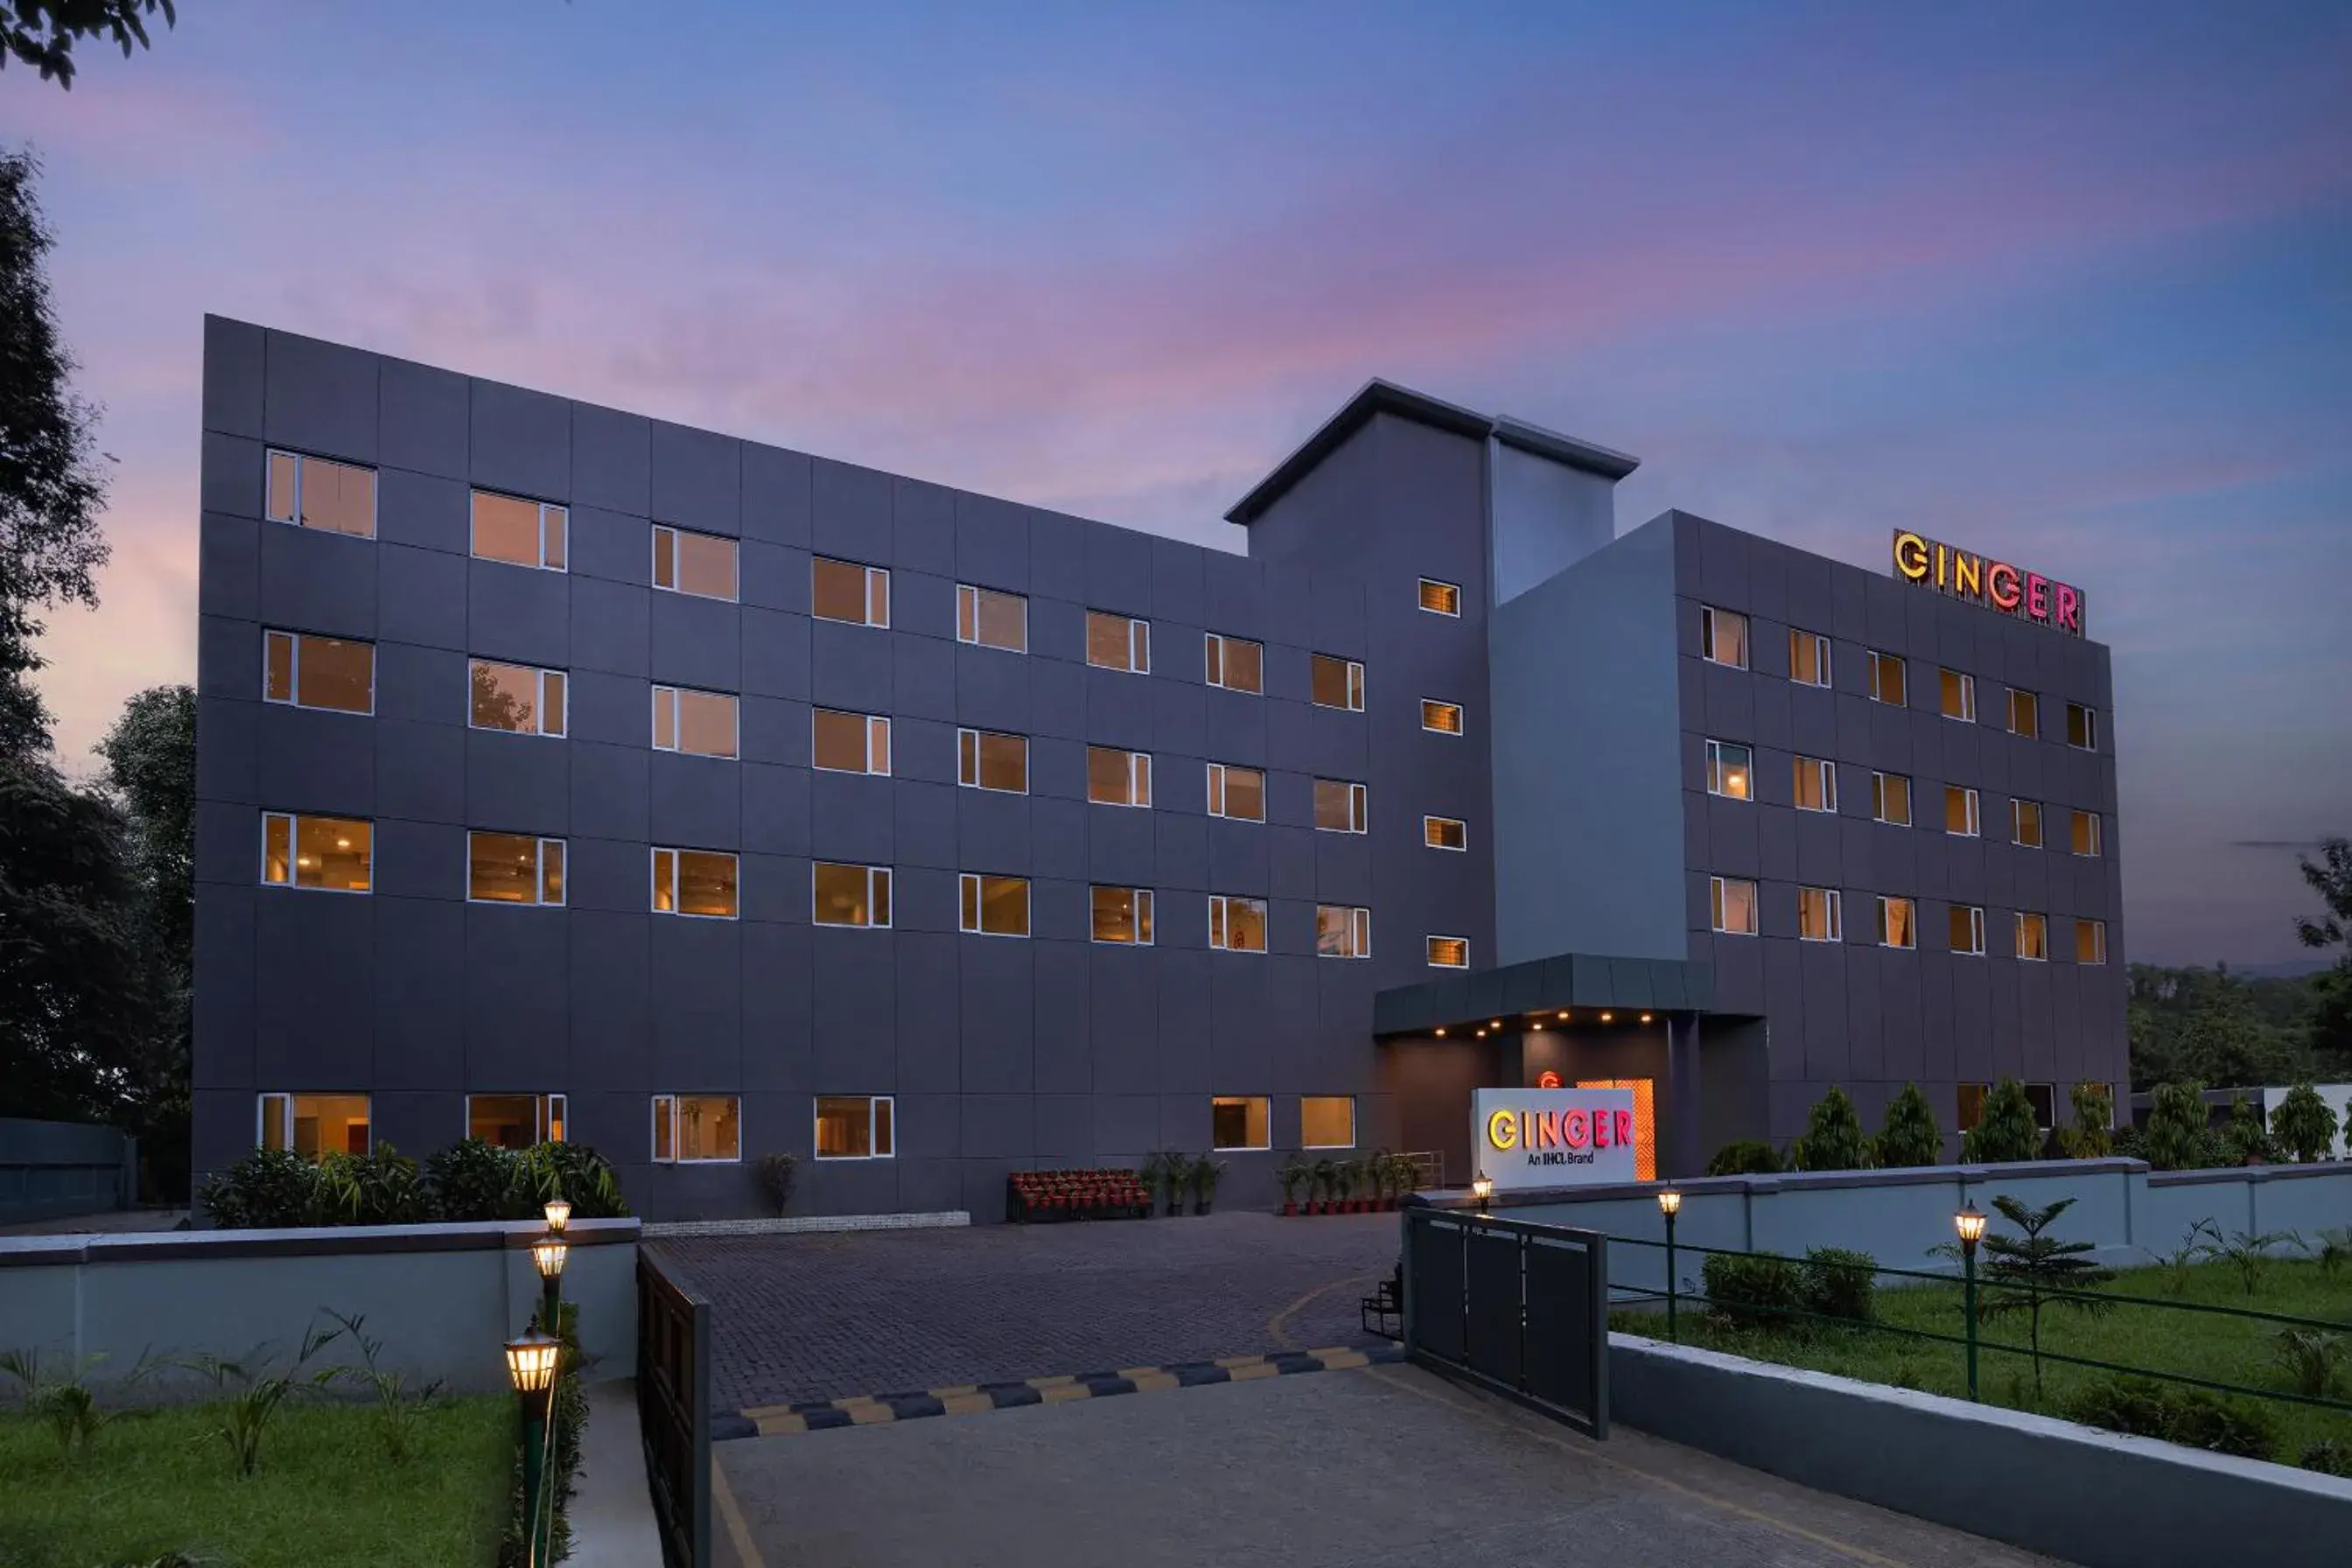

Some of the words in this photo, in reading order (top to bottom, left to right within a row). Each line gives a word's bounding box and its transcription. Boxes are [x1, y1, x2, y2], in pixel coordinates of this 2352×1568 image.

[1894, 532, 2078, 629] GINGER
[1488, 1109, 1632, 1150] GINGER
[1529, 1153, 1540, 1166] An
[1567, 1152, 1594, 1165] Brand
